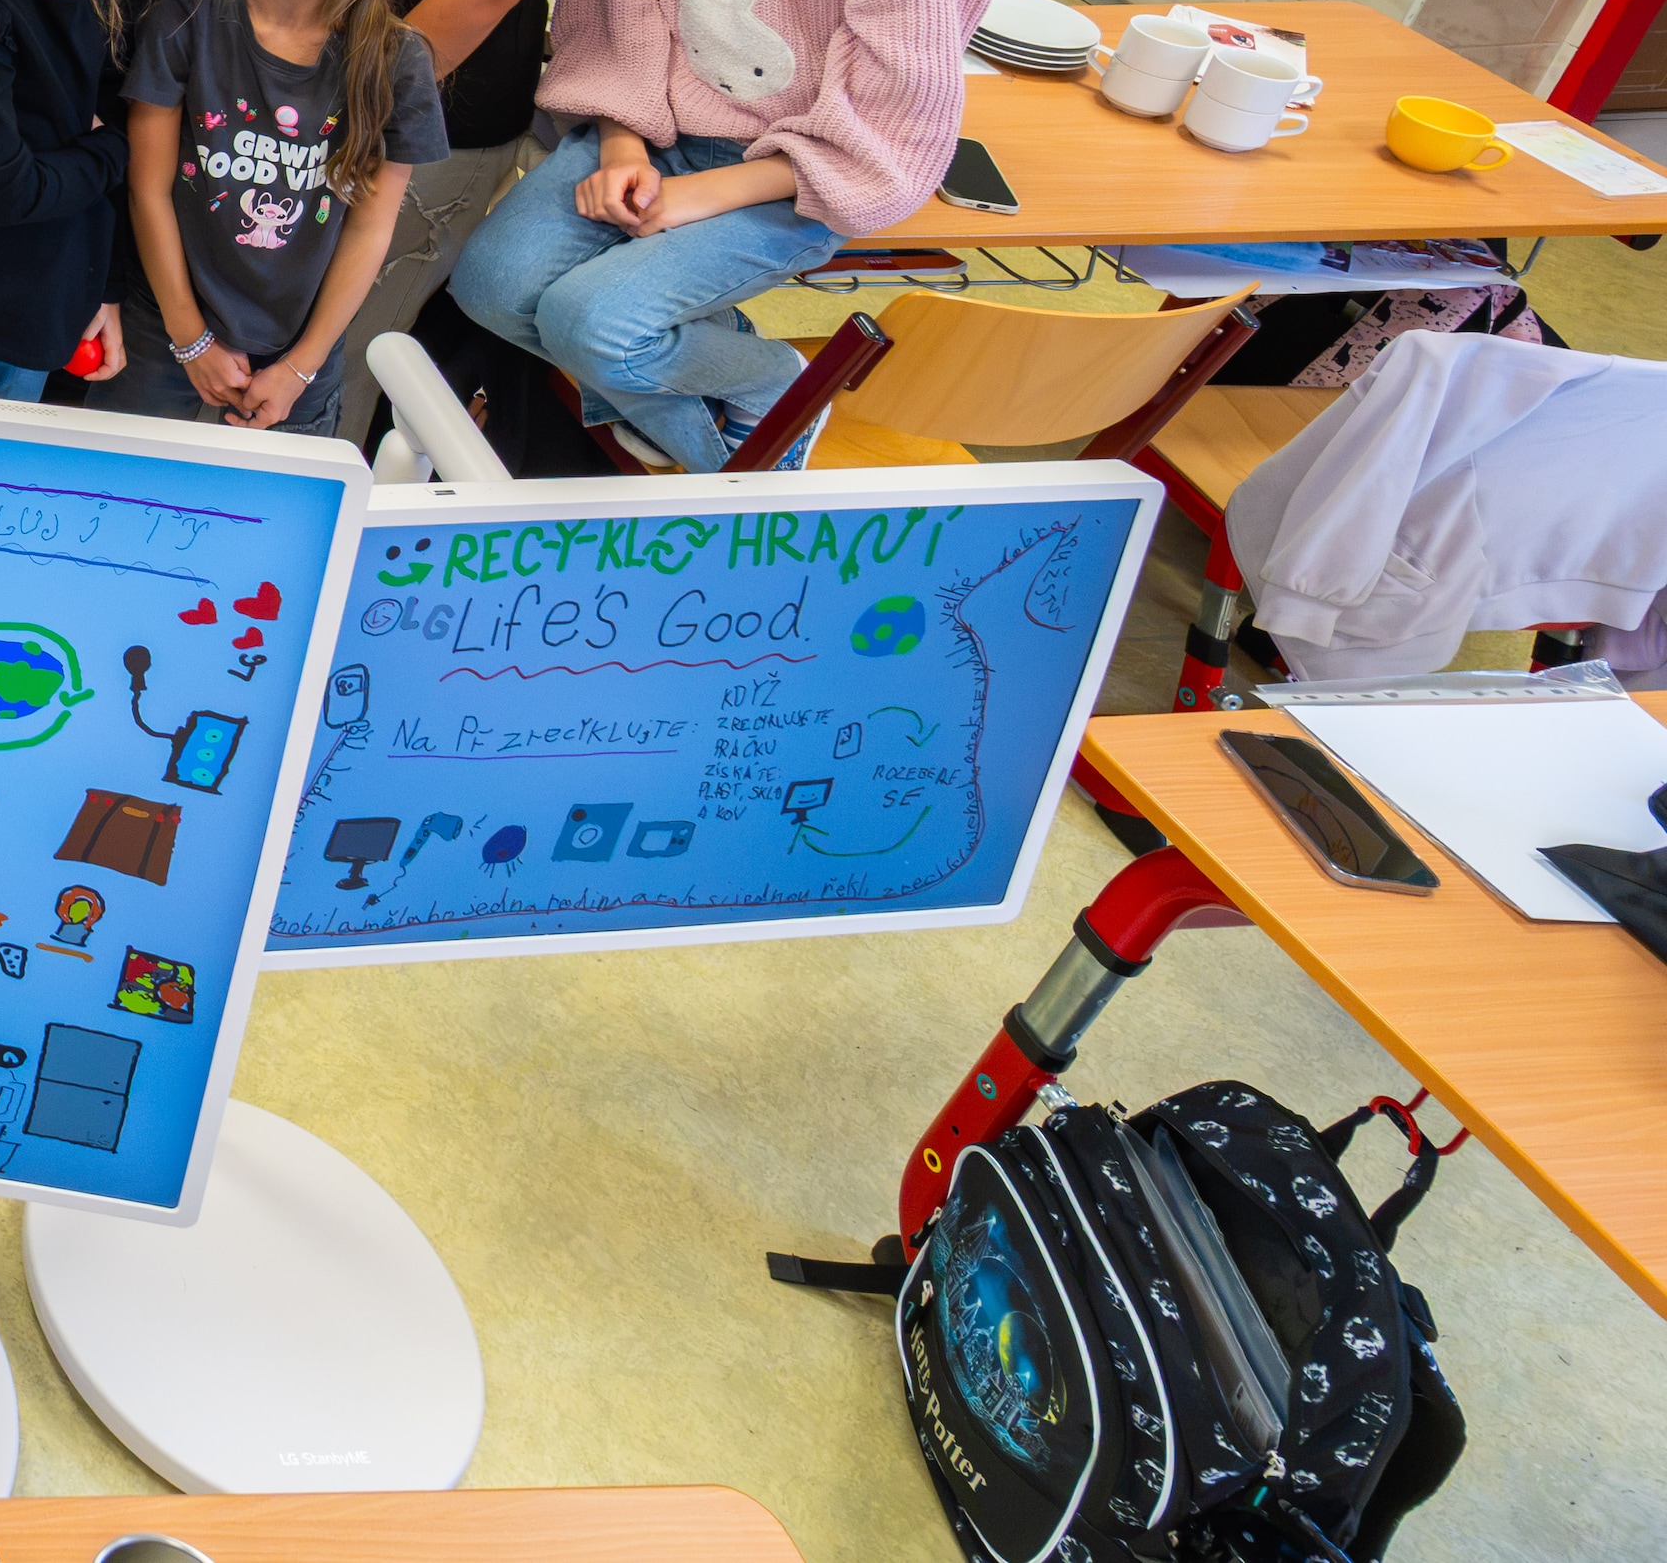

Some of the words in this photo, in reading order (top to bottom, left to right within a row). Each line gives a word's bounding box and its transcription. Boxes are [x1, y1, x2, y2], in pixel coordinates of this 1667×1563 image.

[195, 144, 278, 186] GOOD
[234, 129, 329, 170] GRWM
[657, 575, 811, 648] Good.
[278, 1452, 301, 1467] LG
[301, 1450, 373, 1468] StanbyME
[924, 1389, 988, 1494] Potter
